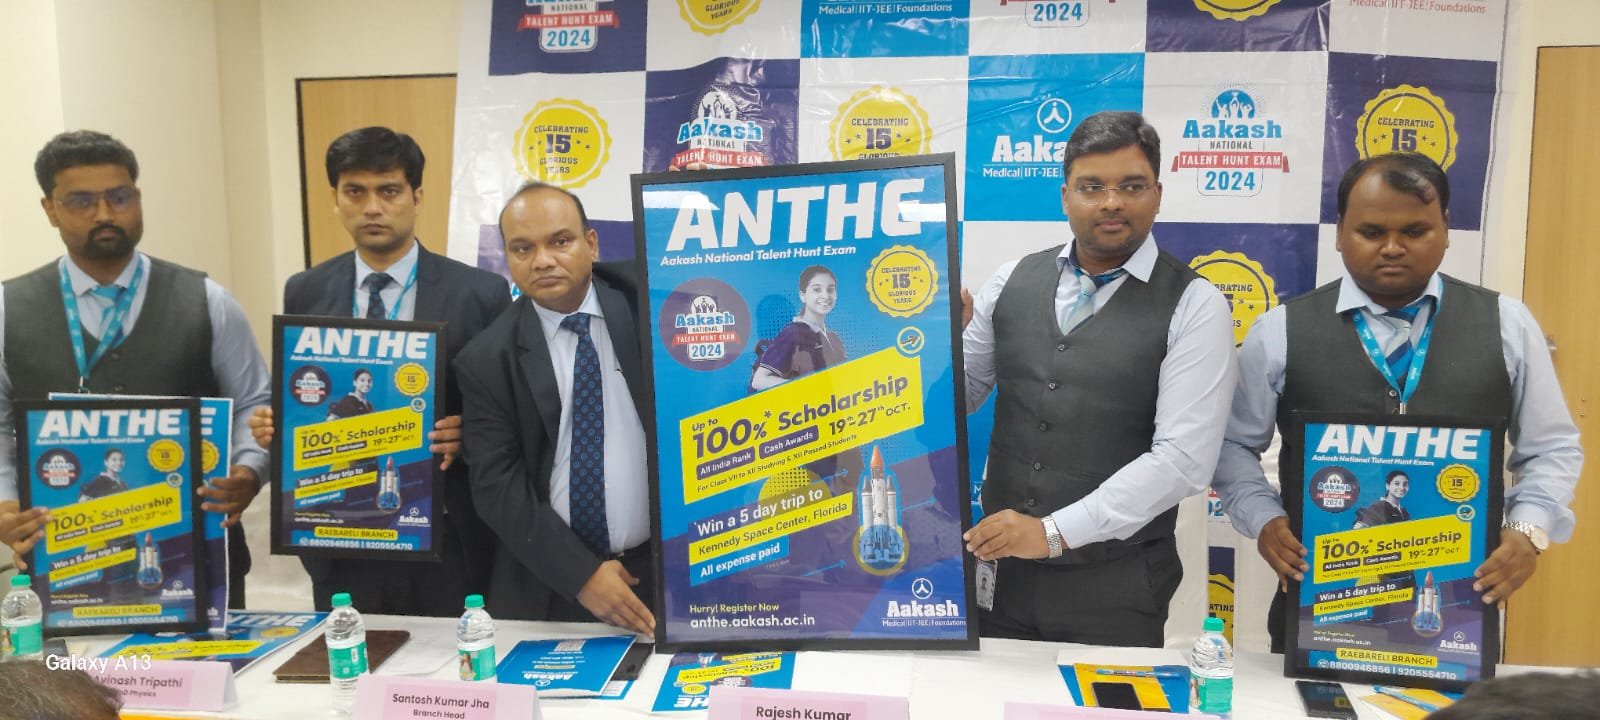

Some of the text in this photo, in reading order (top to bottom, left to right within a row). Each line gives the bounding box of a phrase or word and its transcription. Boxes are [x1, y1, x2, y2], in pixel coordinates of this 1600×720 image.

[551, 3, 588, 11] NATIONAL
[711, 8, 733, 20] YEARS
[1033, 2, 1083, 21] 2024
[526, 13, 613, 27] TALENT HUNT EXAM
[547, 29, 591, 47] 2024
[534, 125, 589, 134] CELEBRATING
[677, 117, 763, 143] Aakash
[851, 117, 909, 126] CELEBRATING
[1182, 119, 1282, 139] Aakash
[1377, 117, 1434, 128] CELEBRATING
[546, 133, 572, 154] 15
[866, 127, 892, 150] 15
[1209, 140, 1254, 150] NATIONAL
[1391, 128, 1417, 152] 15
[991, 134, 1067, 163] Aaka
[677, 152, 763, 165] TALENT HUNT EXAM
[1181, 154, 1281, 166] TALENT HUNT EXAM
[983, 167, 1020, 177] Medical
[1205, 171, 1255, 190] 2024
[666, 178, 925, 252] ANTHE
[660, 245, 856, 266] Aakash National Talent Hunt Exam
[892, 273, 911, 289] 15
[1214, 283, 1253, 292] BRATING
[675, 311, 735, 328] Aakash
[293, 327, 430, 360] ANTHE
[692, 344, 722, 357] 2024
[778, 375, 908, 431] Scholarship
[38, 409, 183, 438] ANTHE
[347, 420, 416, 441] Scholarship
[692, 418, 718, 432] Up to
[764, 432, 814, 454] Cash Awards
[1316, 424, 1481, 460] ANTHE
[697, 485, 708, 493] For
[757, 459, 786, 473] Studying
[804, 440, 827, 456] Passed
[828, 434, 857, 448] Students
[700, 452, 752, 476] All India Rank
[1339, 455, 1370, 463] National
[1371, 456, 1393, 464] Talent
[101, 496, 173, 520] Scholarship
[695, 489, 823, 537] Win a 5 day trip to
[361, 530, 394, 539] BRANCH
[699, 502, 848, 556] Kennedy Space Center, Florida
[1376, 530, 1462, 553] Scholarship
[700, 565, 713, 578] All
[715, 553, 757, 573] expense
[758, 543, 781, 560] paid
[1320, 593, 1336, 602] Win
[1352, 587, 1368, 596] day
[1370, 585, 1385, 594] trip
[690, 603, 780, 614] Hurry! Register Now
[887, 599, 959, 617] Aakash
[690, 614, 816, 629] anthe.aakash.ac.in
[1439, 640, 1477, 651] Aakash
[1340, 650, 1433, 666] RAEBARELI BRANCH
[1330, 661, 1457, 679] 8800946856 9205554710
[140, 676, 183, 690] Tripathi
[130, 690, 156, 698] Physics
[392, 693, 490, 709] Santosh Kumar Jha
[413, 709, 465, 720] Branch Head
[756, 706, 851, 720] Rajesh Kumar
